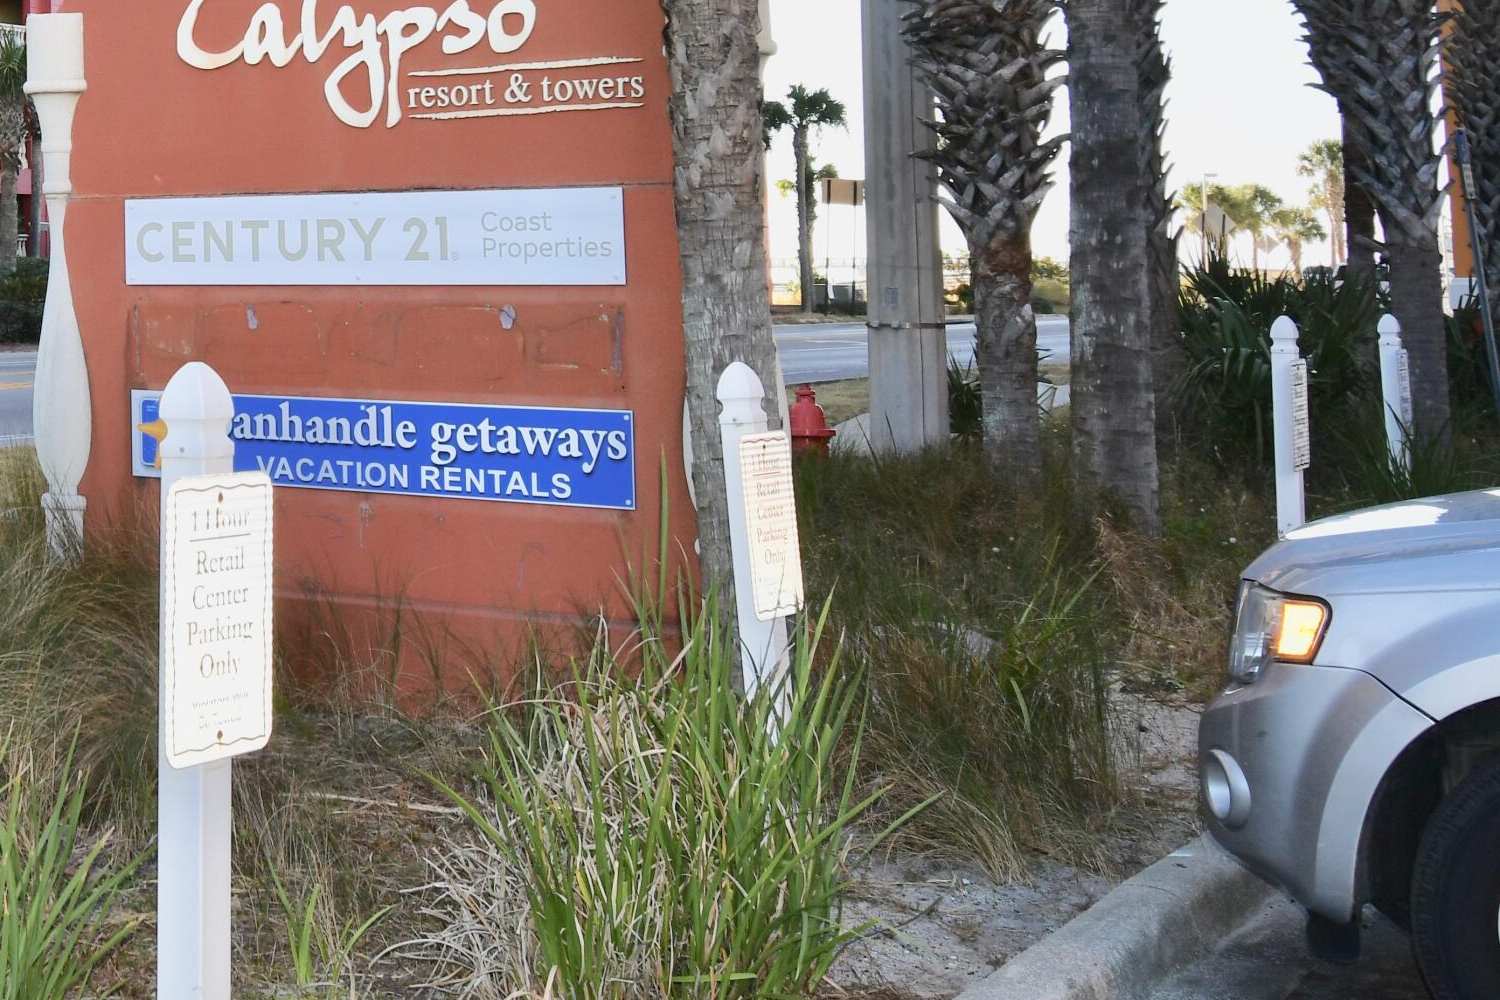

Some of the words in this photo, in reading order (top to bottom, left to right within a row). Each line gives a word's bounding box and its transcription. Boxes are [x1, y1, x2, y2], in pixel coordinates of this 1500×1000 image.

[407, 79, 496, 108] resort
[504, 72, 533, 103] &
[540, 75, 645, 102] towers
[481, 211, 554, 233] Coast
[136, 217, 386, 263] CENTURY
[483, 236, 613, 264] Properties
[227, 401, 418, 449] anhandle
[430, 417, 628, 475] getaways
[256, 455, 409, 489] VACATION
[420, 465, 572, 499] RENTALS
[196, 545, 245, 576] Retail
[192, 585, 249, 610] Center
[187, 615, 254, 646] Parking
[200, 650, 241, 681] Only
